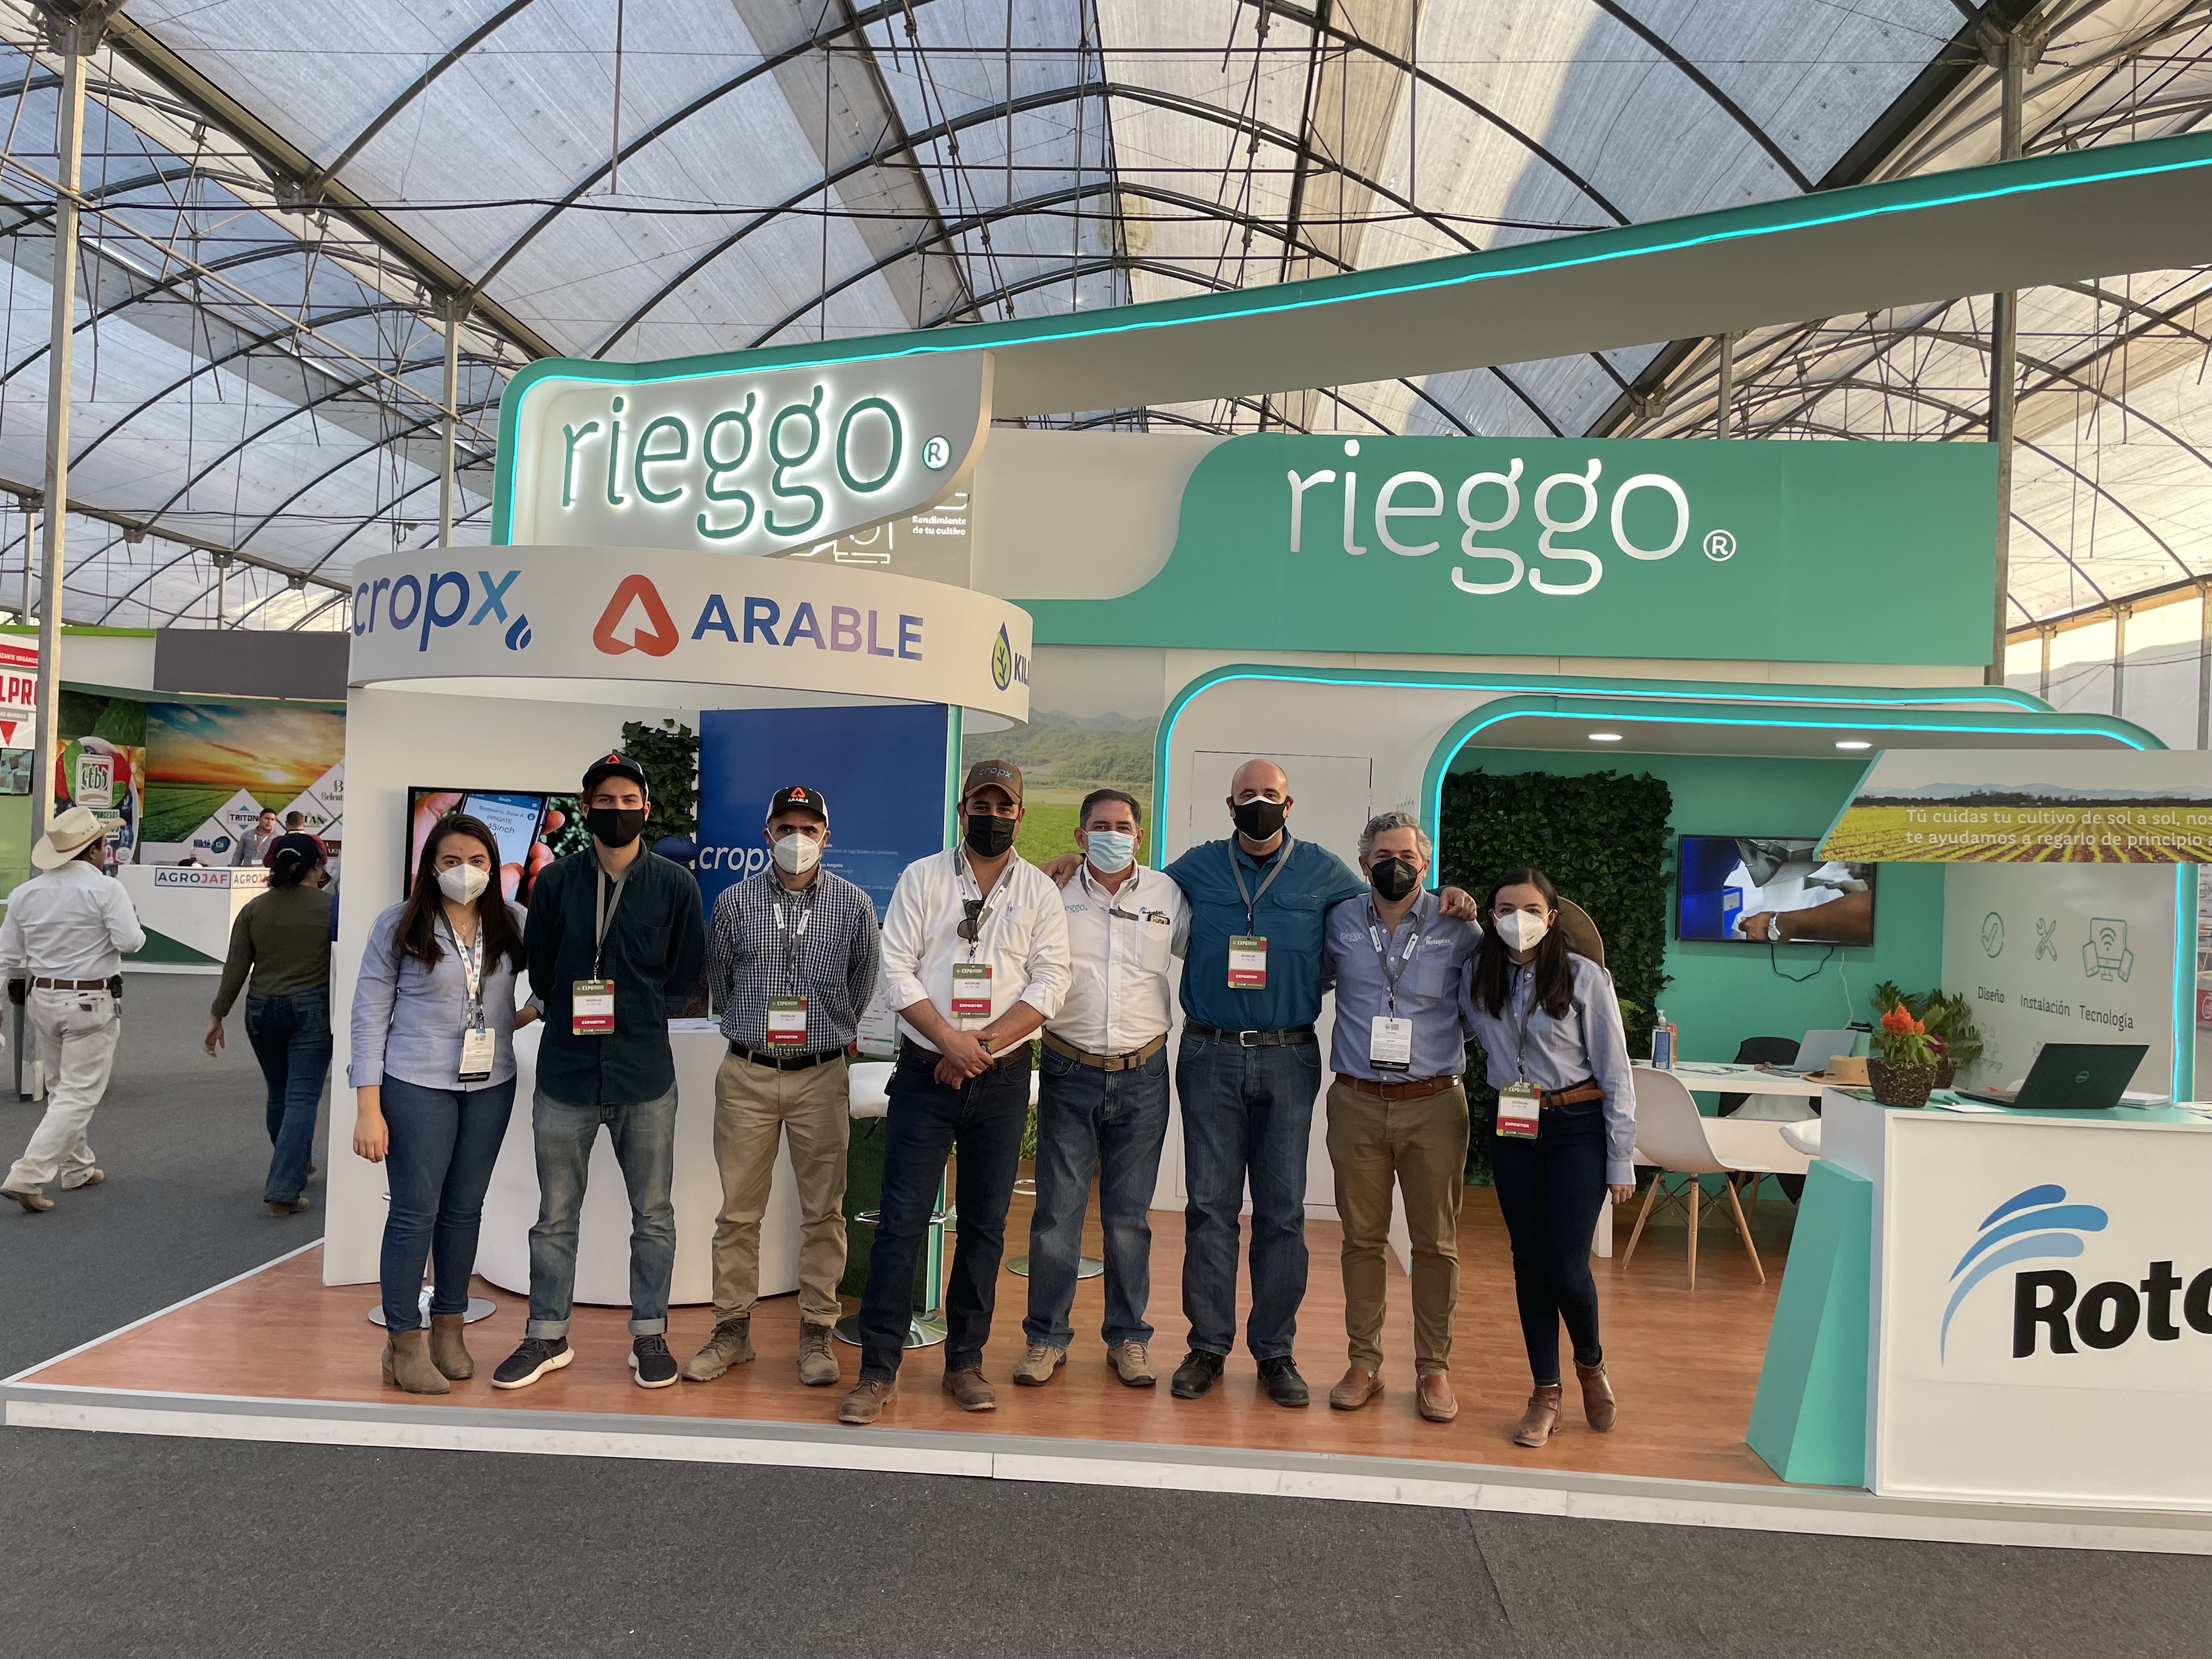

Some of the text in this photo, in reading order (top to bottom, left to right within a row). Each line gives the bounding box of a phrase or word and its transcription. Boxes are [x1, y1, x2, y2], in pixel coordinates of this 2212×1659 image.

[563, 385, 902, 539] rieggo
[1288, 439, 1689, 595] rieggo
[936, 527, 966, 535] cultivo
[354, 571, 522, 652] cropx
[691, 594, 923, 661] ARABLE
[979, 768, 1012, 778] cropx
[486, 815, 512, 824] IRRIGATE
[1906, 809, 1927, 822] Tú
[1933, 809, 1988, 823] cuidas
[1993, 812, 2012, 823] tu
[2017, 810, 2075, 824] cultivo
[2081, 810, 2102, 824] de
[2107, 810, 2130, 825] sol
[2137, 814, 2146, 824] a
[2152, 811, 2180, 826] sol,
[1906, 831, 1923, 843] te
[1928, 830, 2016, 847] ayudamos
[2022, 834, 2032, 844] a
[2038, 831, 2095, 849] regarlo
[2101, 831, 2121, 845] de
[2128, 832, 2202, 849] principio
[158, 872, 228, 884] AGROJAF
[234, 873, 268, 884] AGROJ
[1064, 904, 1088, 913] eggo.
[1978, 986, 2134, 1031] Diseño Instalación Tecnología
